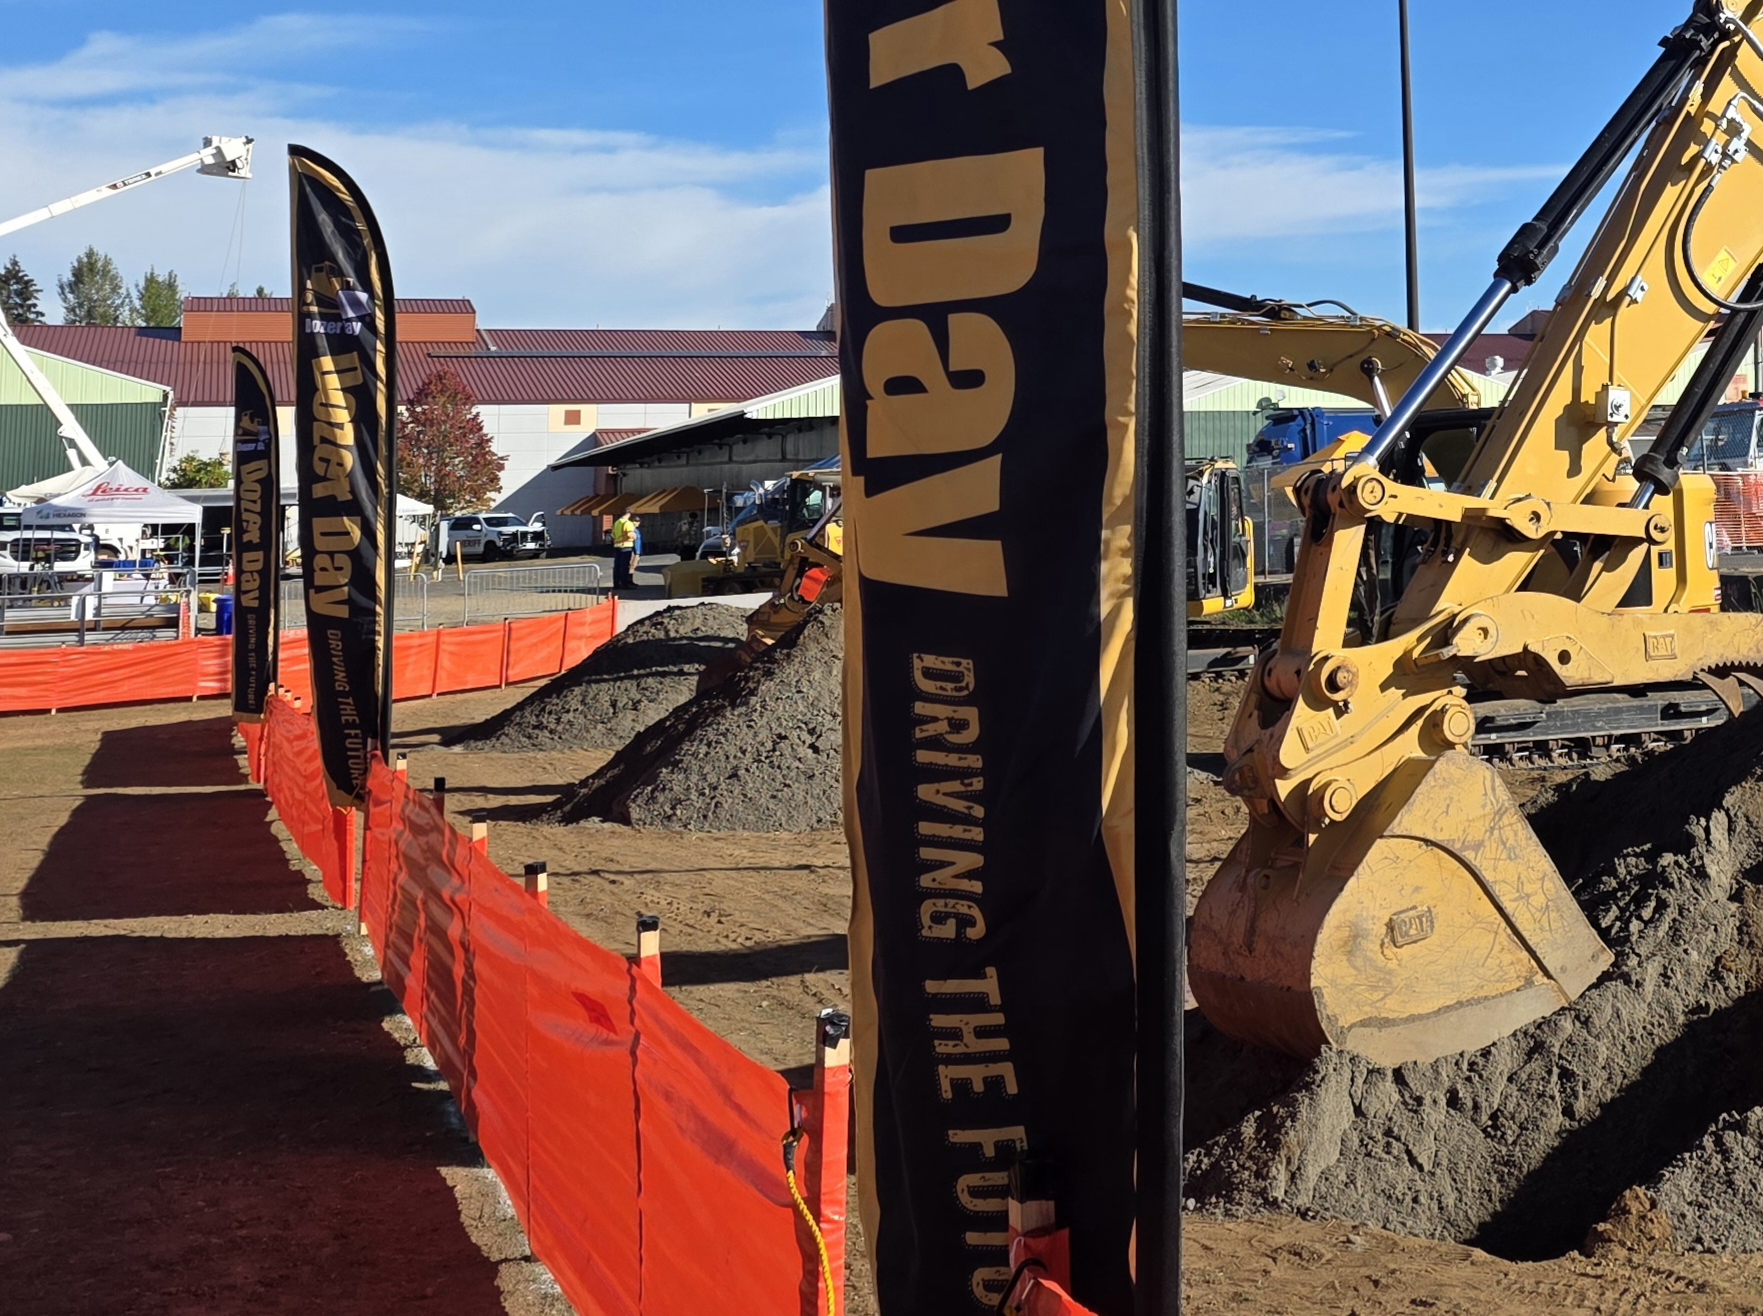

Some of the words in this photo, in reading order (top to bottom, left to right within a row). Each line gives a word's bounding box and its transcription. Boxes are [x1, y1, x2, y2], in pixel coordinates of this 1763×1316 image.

[858, 146, 1046, 598] Day
[311, 351, 364, 502] Dozer
[82, 481, 151, 497] Leica
[239, 459, 269, 543] Dozer
[240, 550, 264, 608] Day
[309, 516, 362, 619] Day
[247, 652, 257, 669] THE
[327, 629, 350, 692] DRIVING
[338, 697, 360, 725] THE
[909, 651, 987, 944] DRIVING
[923, 966, 1019, 1102] THE
